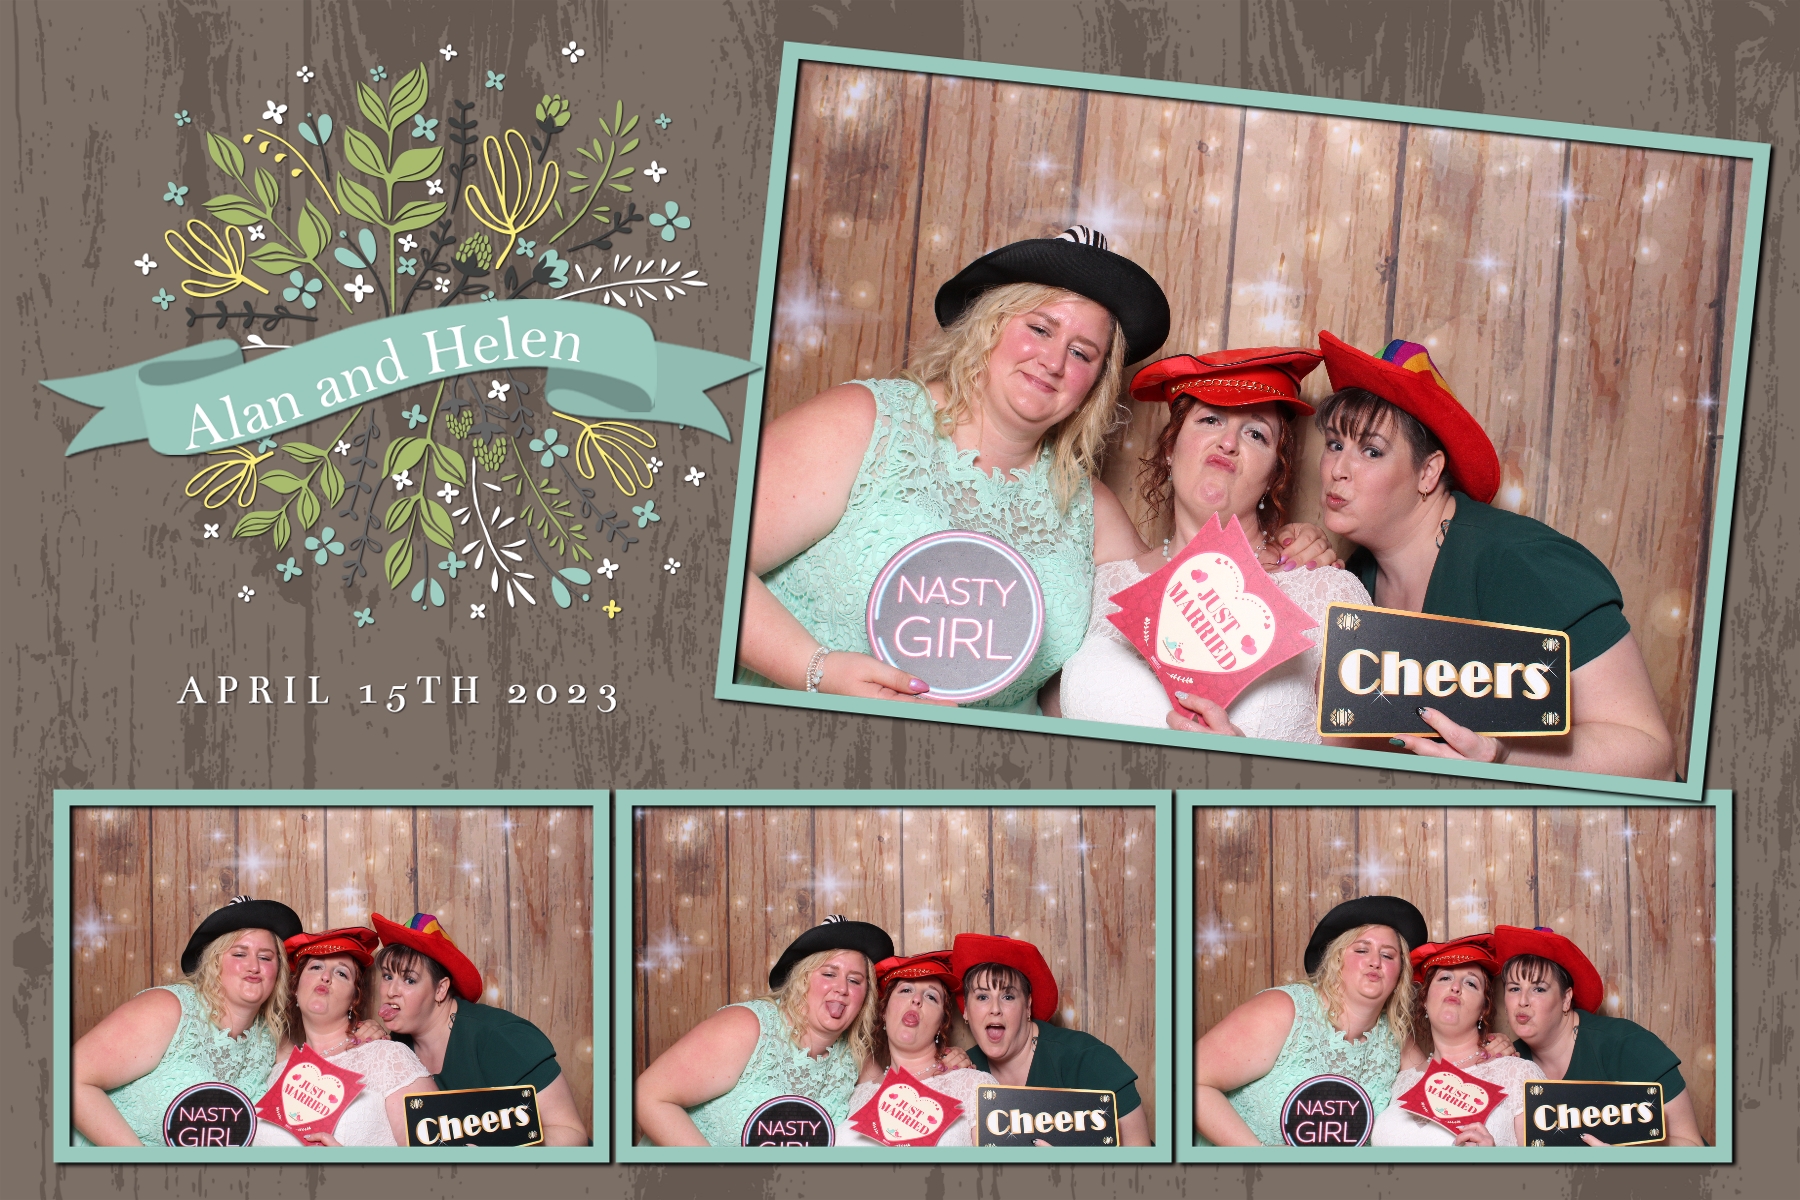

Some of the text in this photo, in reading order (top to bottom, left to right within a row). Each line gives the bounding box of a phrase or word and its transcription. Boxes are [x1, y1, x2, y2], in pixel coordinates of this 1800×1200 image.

[898, 575, 1017, 607] NASTY
[1197, 587, 1241, 634] JUST
[895, 616, 1012, 660] GIRL
[1166, 581, 1237, 670] MARRIED
[1338, 648, 1551, 700] Cheers
[283, 1083, 330, 1116] MARRIED
[299, 1080, 326, 1099] JUST
[1426, 1085, 1478, 1114] MARRIED
[1442, 1084, 1471, 1100] JUST
[179, 1106, 244, 1122] NASTY
[879, 1101, 930, 1135] MARRIED
[896, 1099, 925, 1118] JUST
[985, 1108, 1107, 1135] Cheers
[1296, 1100, 1360, 1116] NASTY
[1532, 1101, 1654, 1132] Cheers
[178, 1127, 240, 1147] GIRL
[415, 1103, 531, 1146] Cheers
[758, 1120, 821, 1136] NASTY
[1295, 1121, 1358, 1143] GIRL
